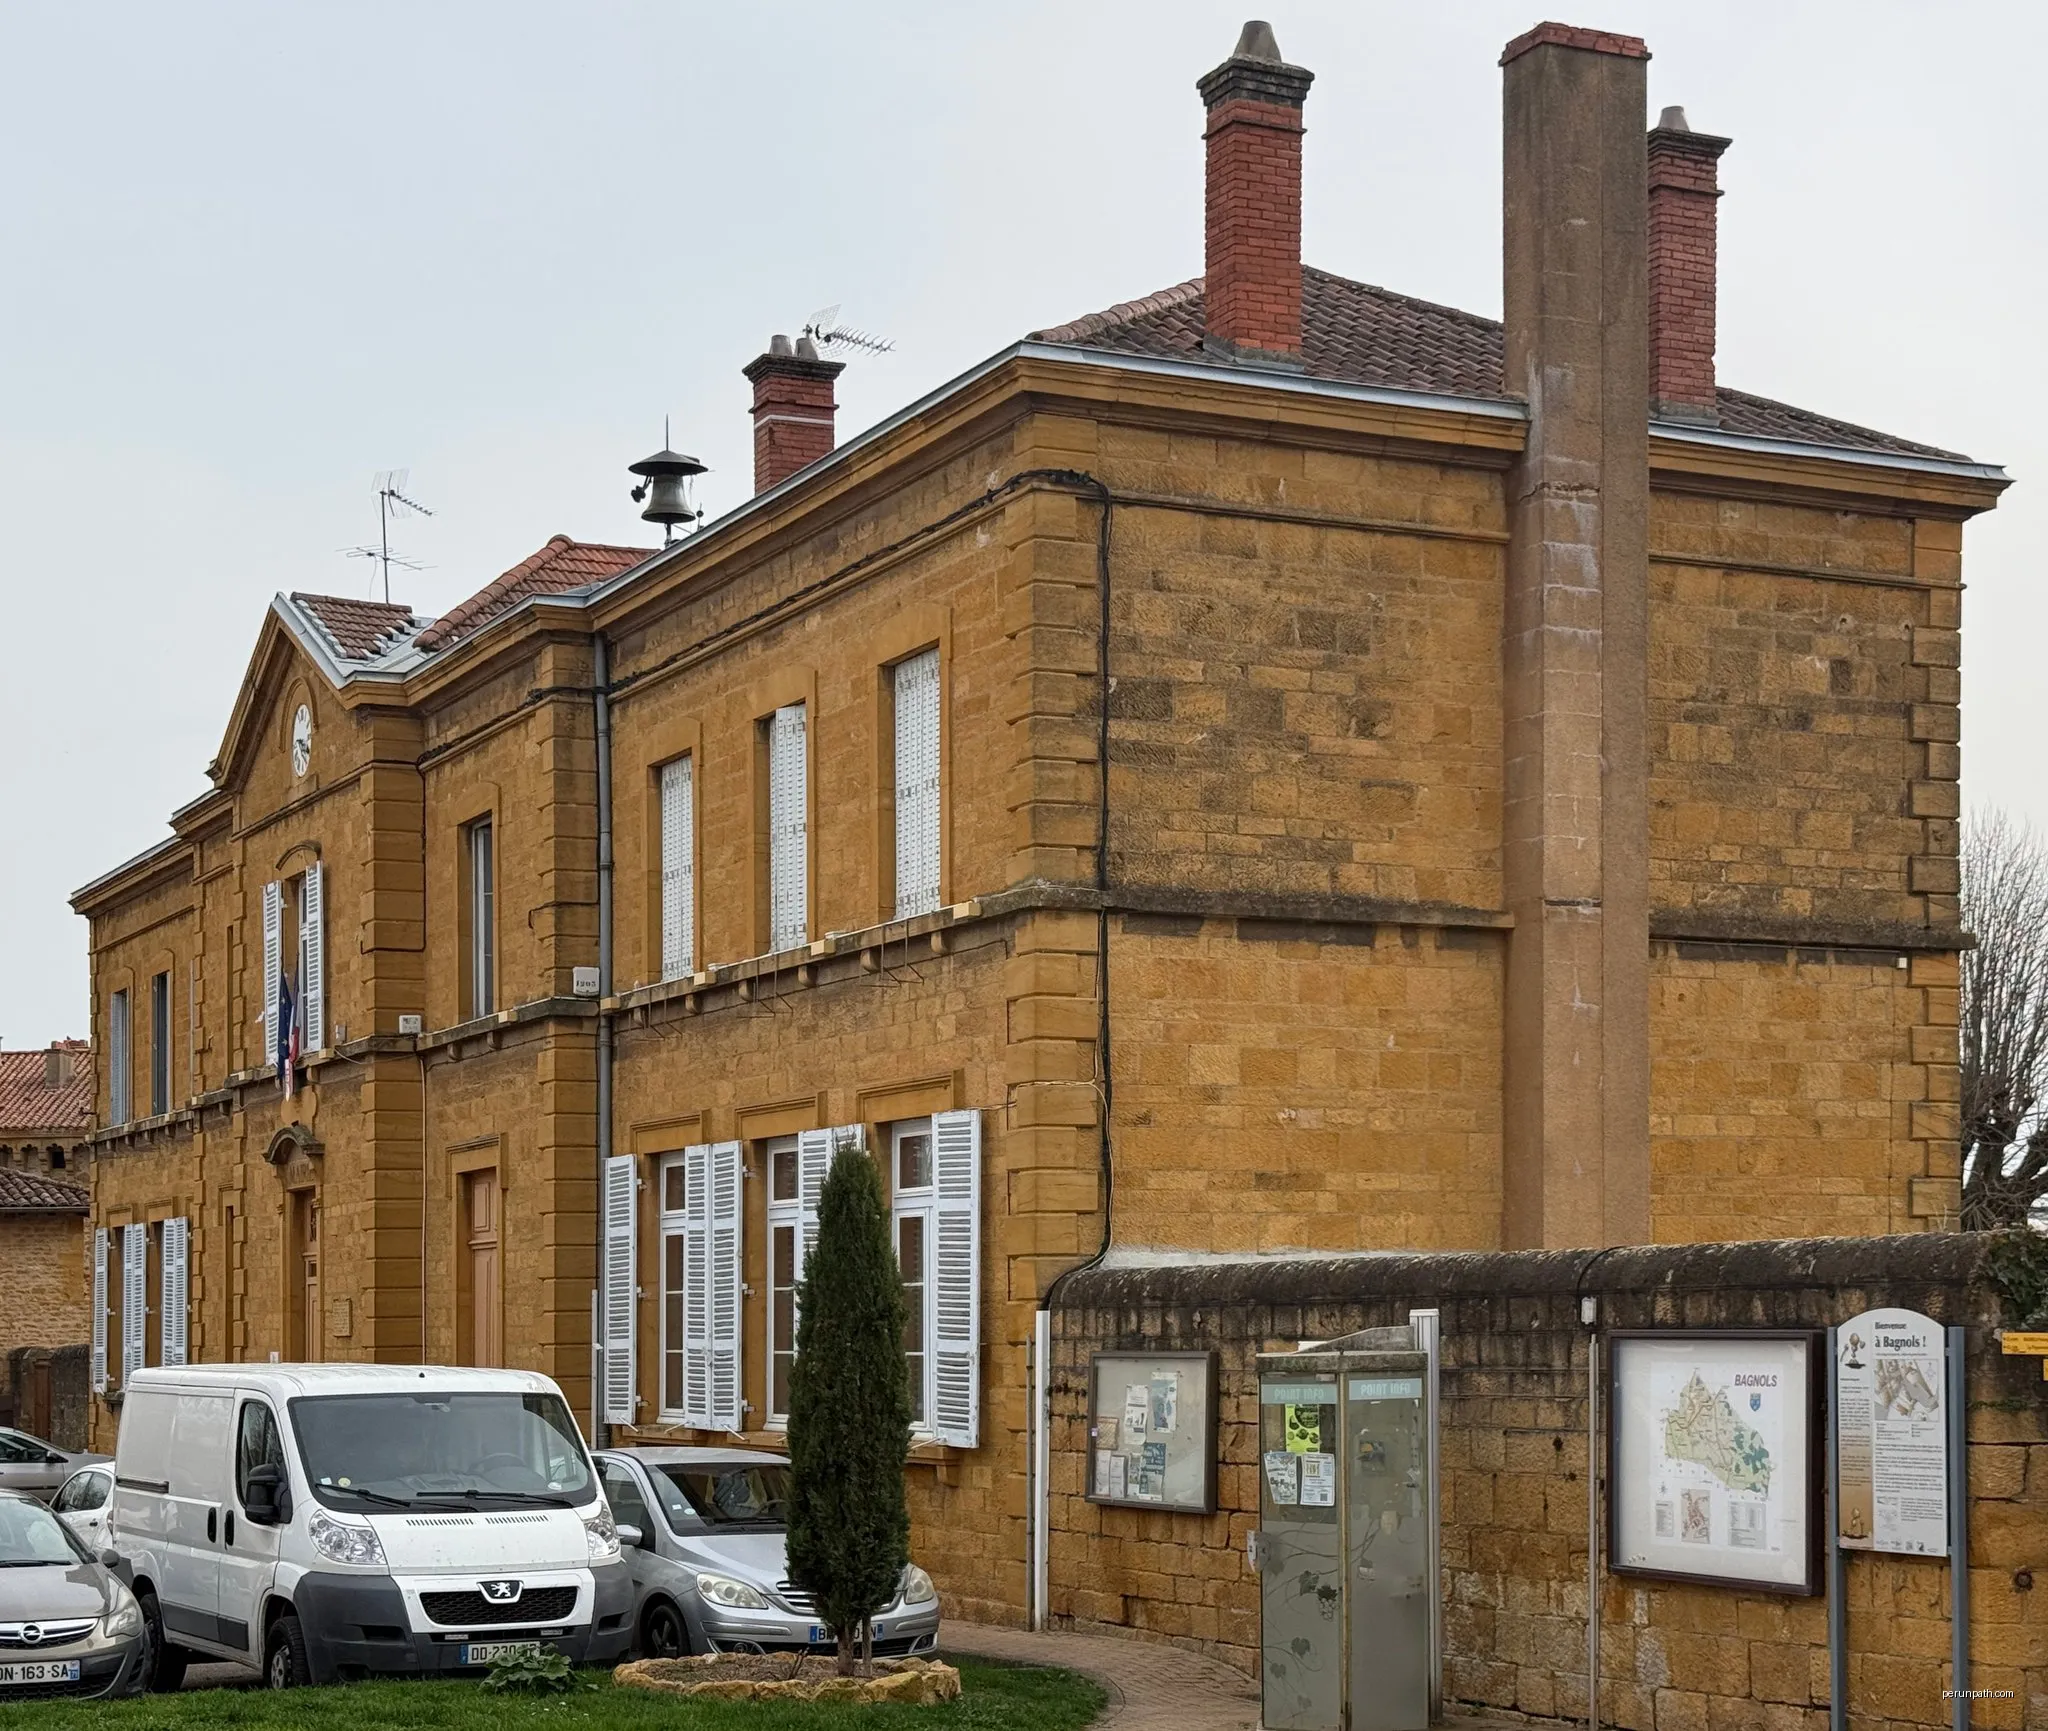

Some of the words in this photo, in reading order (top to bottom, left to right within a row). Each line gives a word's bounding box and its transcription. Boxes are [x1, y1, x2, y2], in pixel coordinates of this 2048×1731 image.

[1874, 1335, 1881, 1348] à
[1883, 1335, 1921, 1352] Bagnols
[1922, 1335, 1927, 1348] !
[1734, 1374, 1778, 1387] BAGNOLS
[1360, 1384, 1387, 1397] POINT
[1390, 1382, 1411, 1395] INFO
